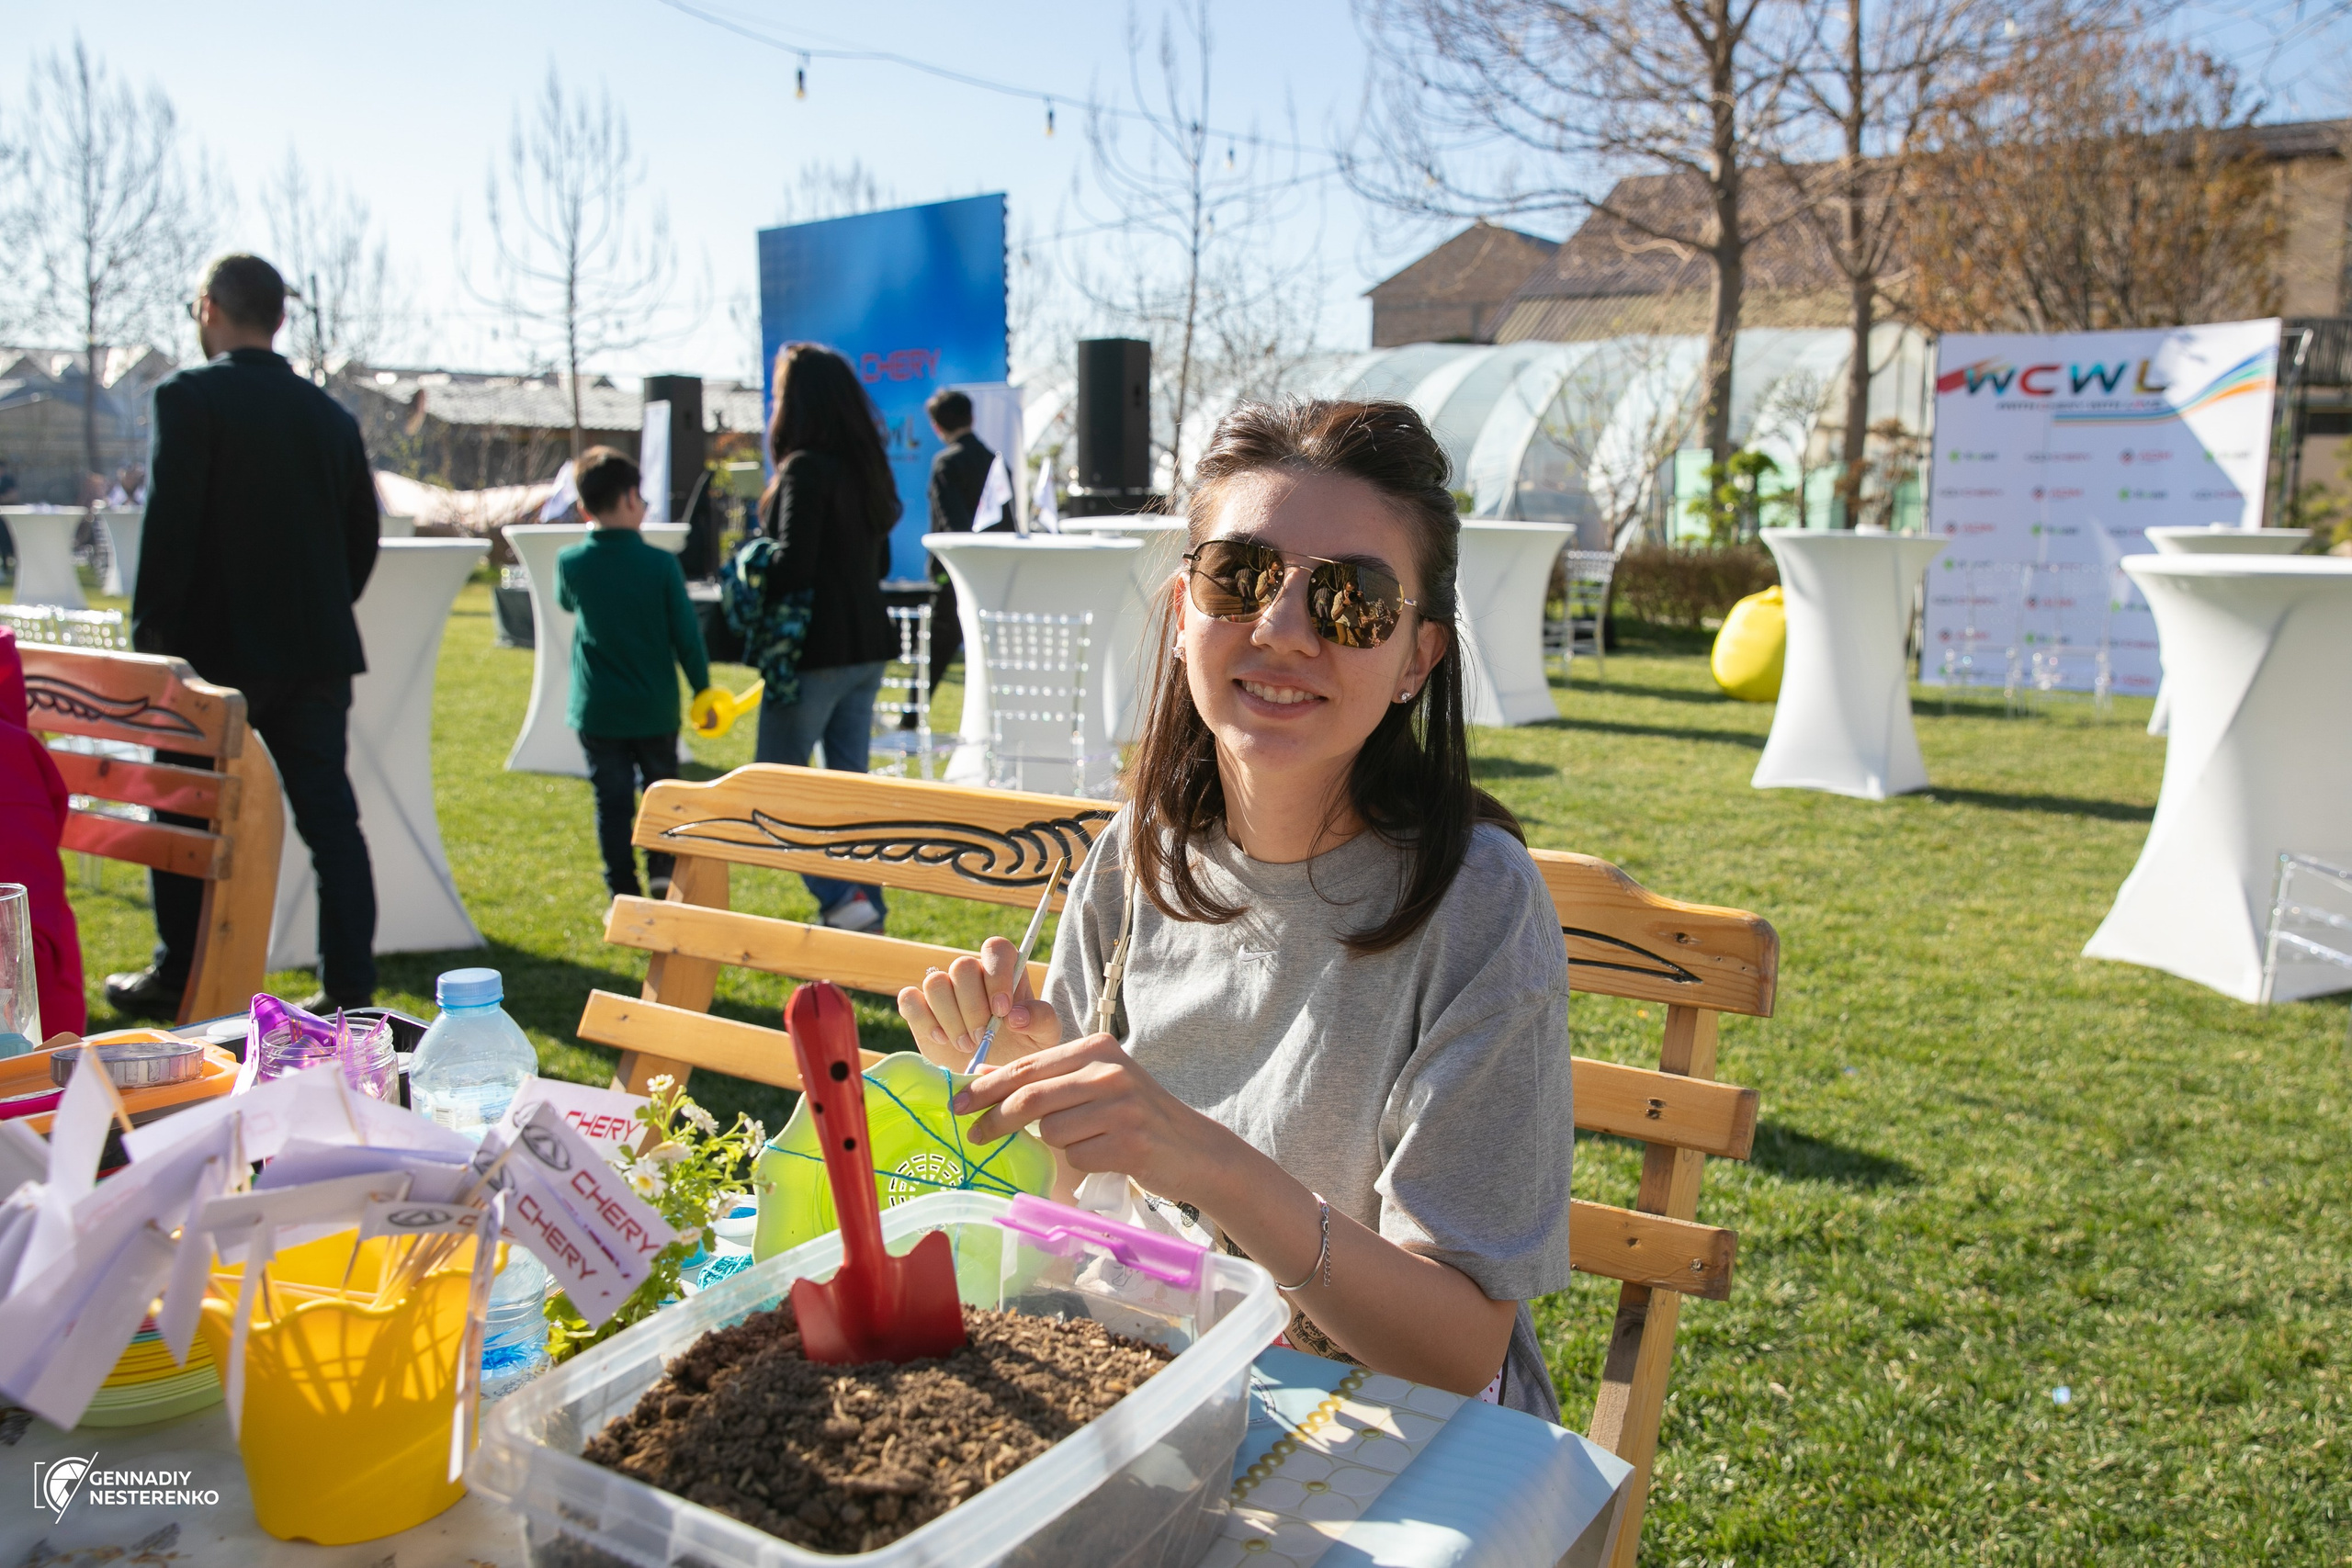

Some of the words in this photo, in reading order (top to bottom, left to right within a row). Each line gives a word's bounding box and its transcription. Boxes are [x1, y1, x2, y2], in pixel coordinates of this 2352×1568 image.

[860, 348, 942, 383] CHERY
[1964, 358, 2170, 397] WCWL
[564, 1110, 642, 1143] CHERY
[571, 1168, 661, 1255] CHERY
[516, 1194, 597, 1280] CHERY
